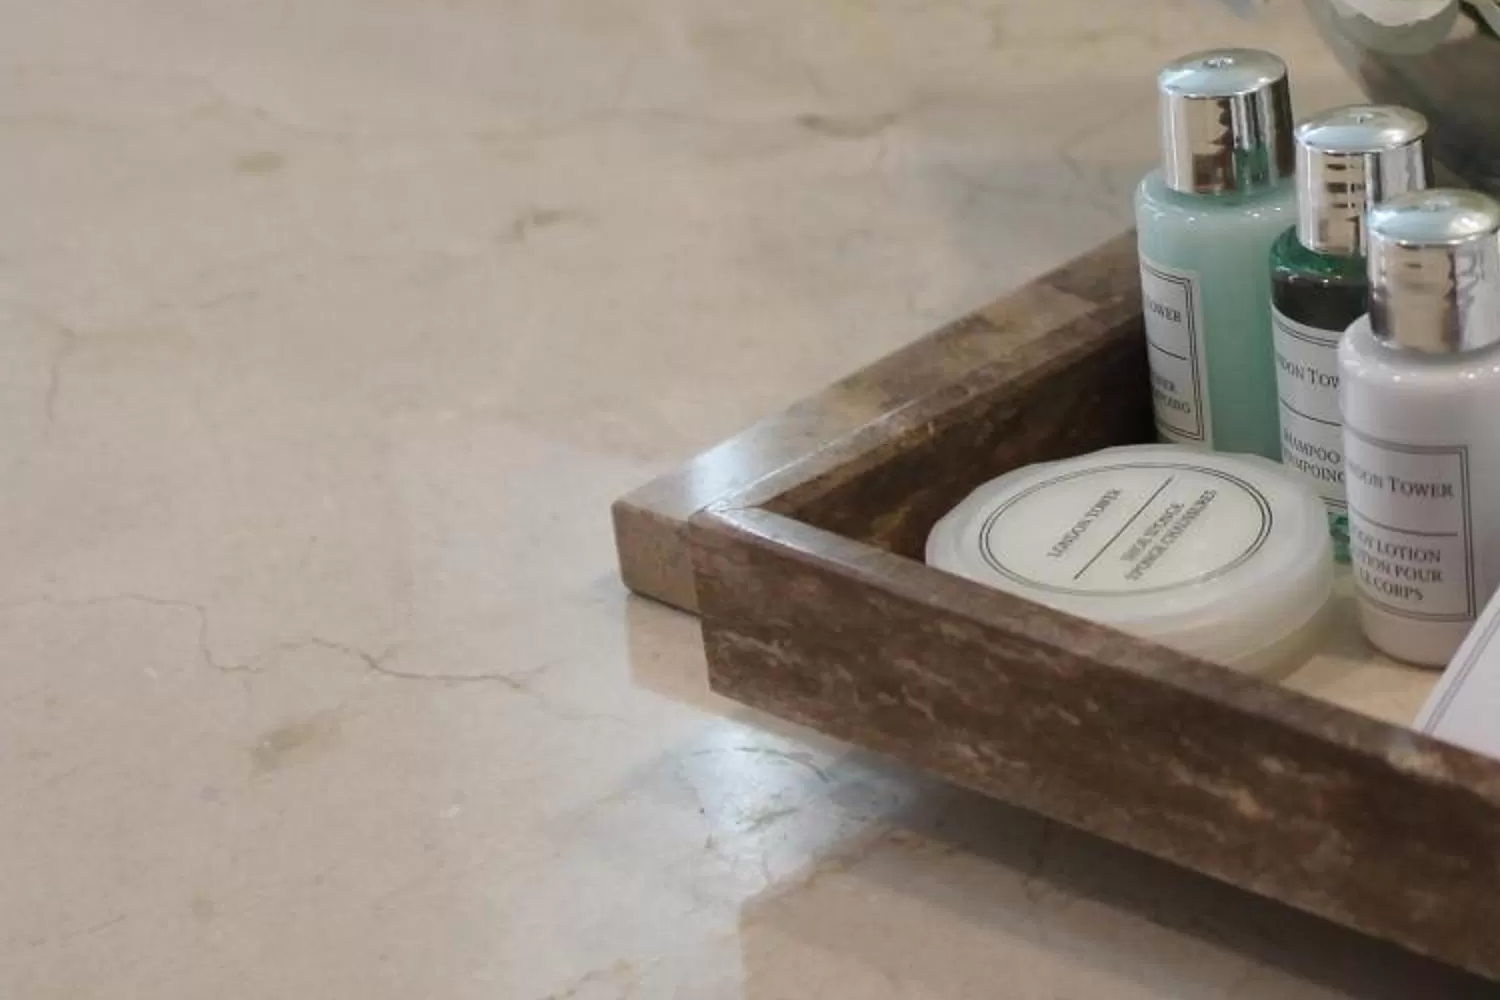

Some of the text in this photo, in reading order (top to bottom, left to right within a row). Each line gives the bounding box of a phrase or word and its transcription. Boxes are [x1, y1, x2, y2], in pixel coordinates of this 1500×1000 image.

[1388, 474, 1454, 498] TOWER
[1046, 519, 1092, 558] LONDON
[1377, 539, 1441, 563] LOTION
[1395, 563, 1444, 583] POUR
[1373, 577, 1424, 601] CORPS
